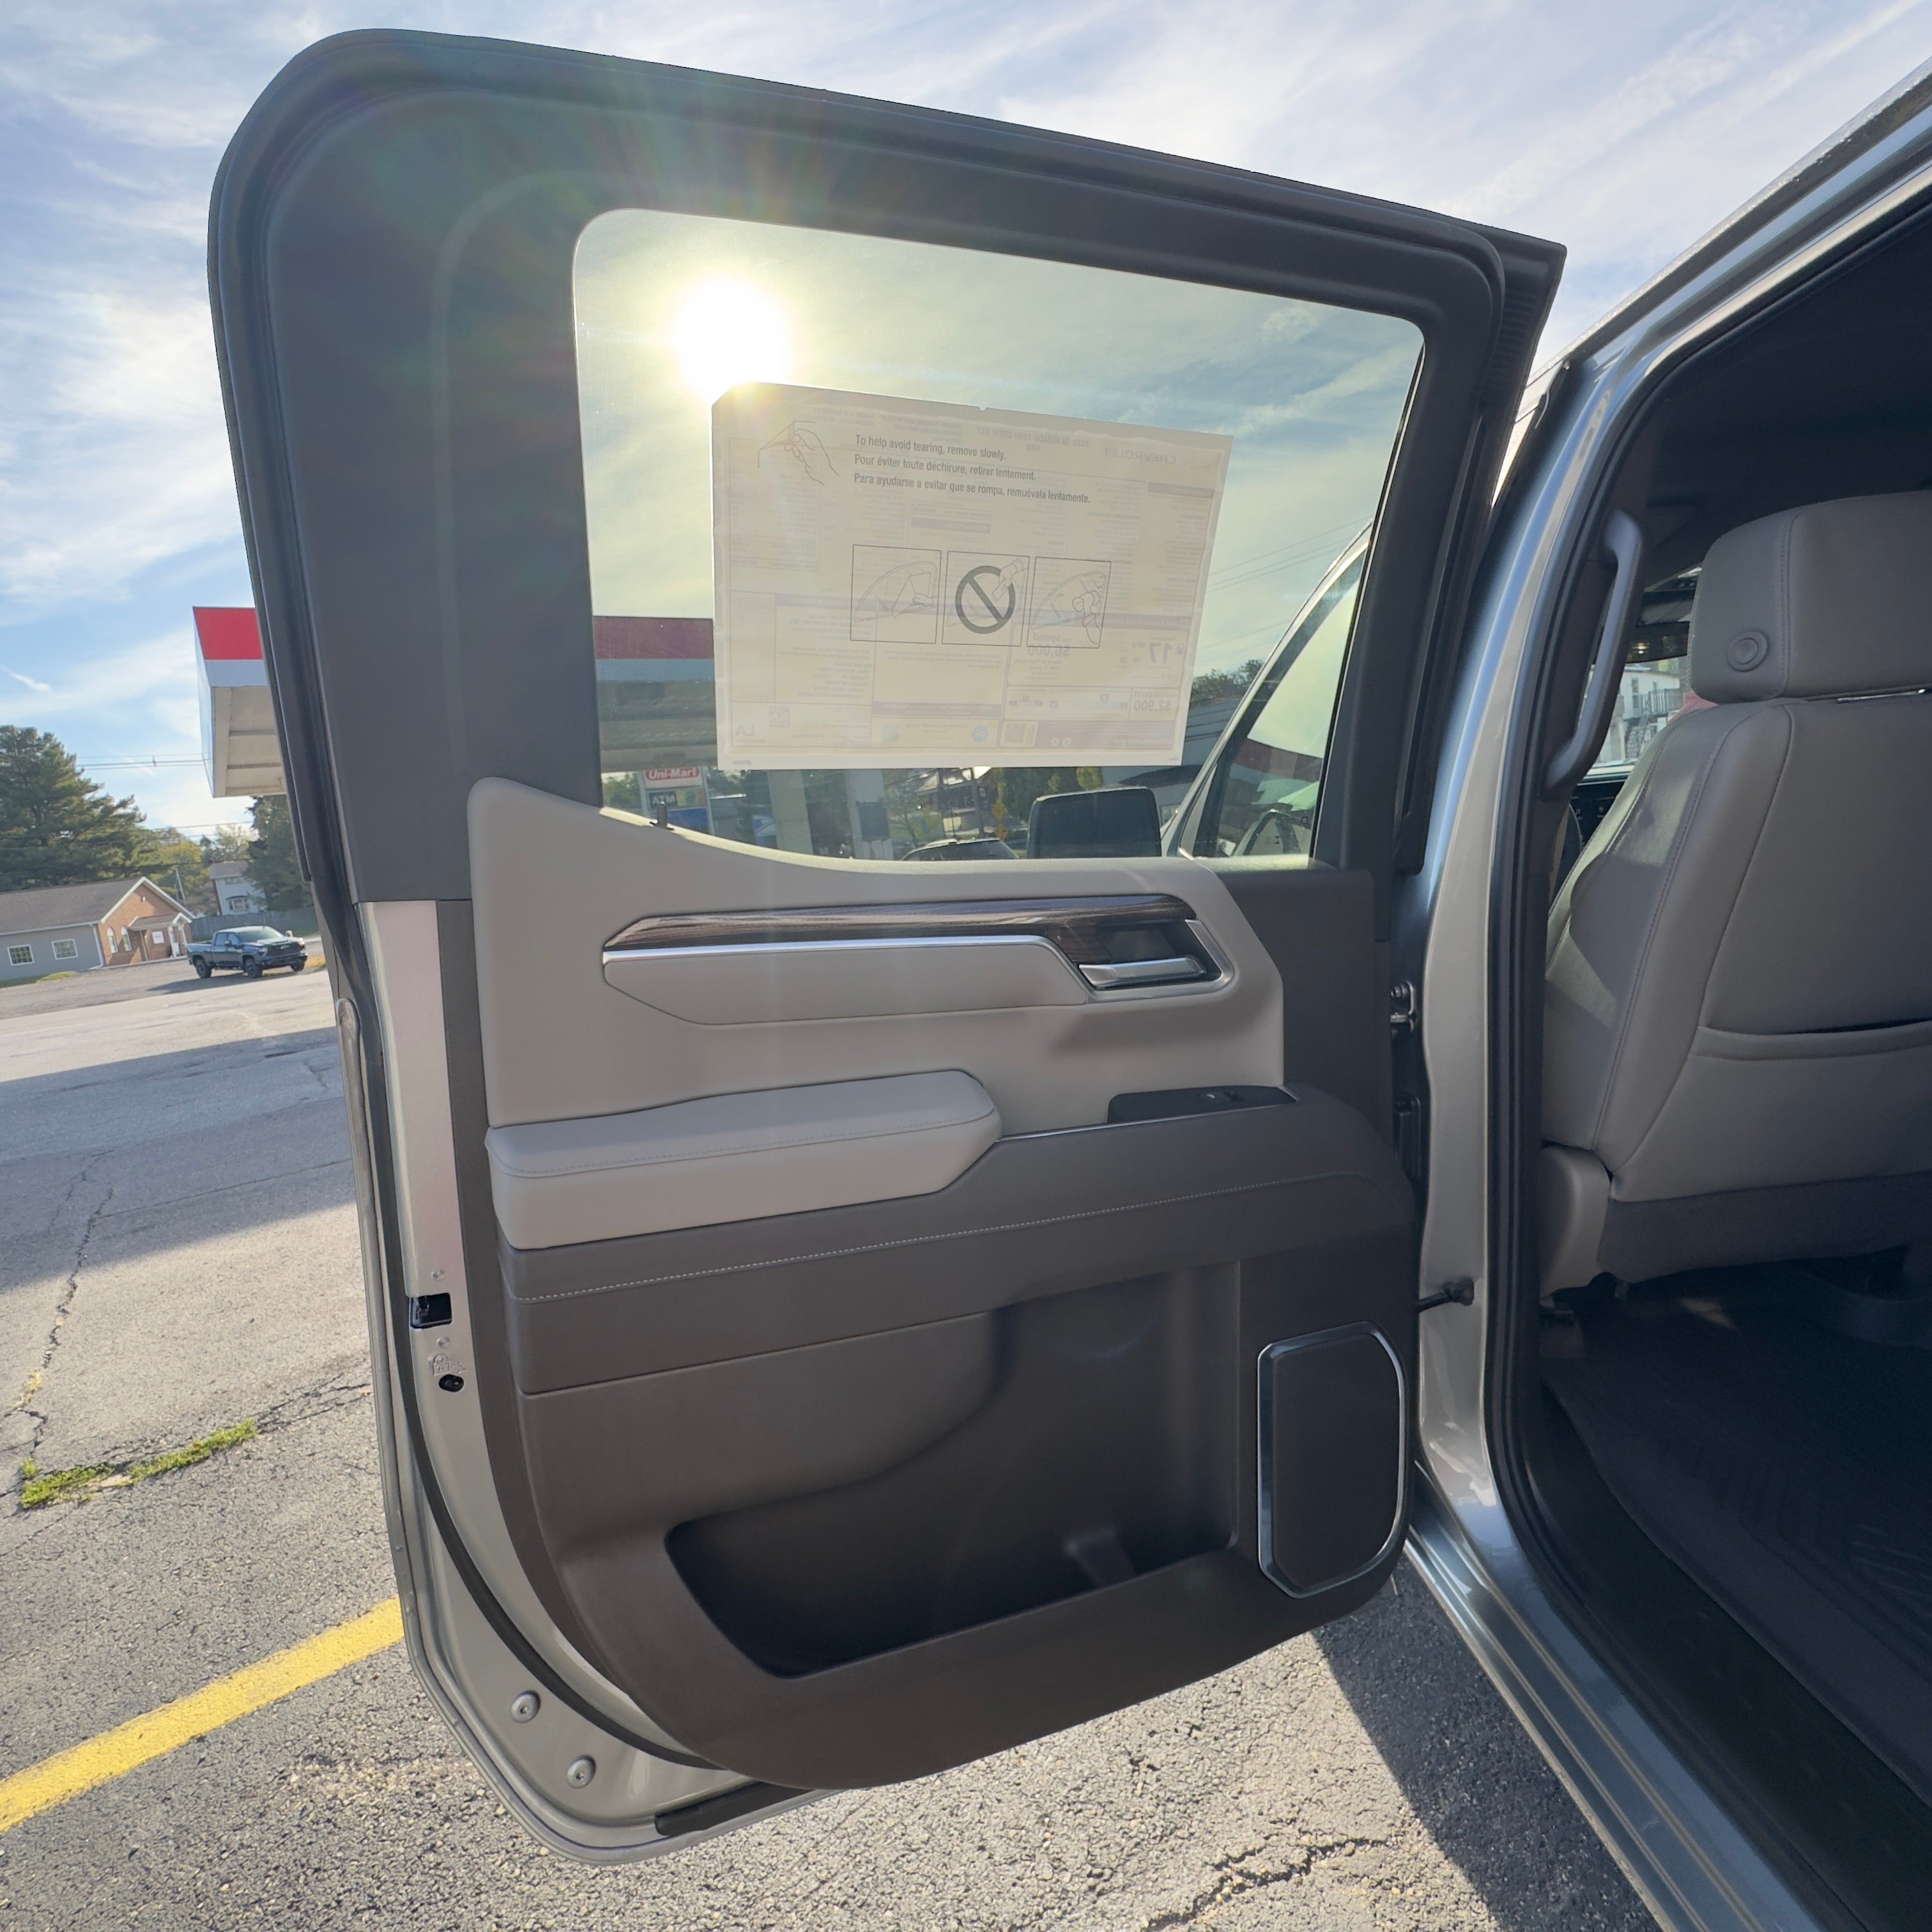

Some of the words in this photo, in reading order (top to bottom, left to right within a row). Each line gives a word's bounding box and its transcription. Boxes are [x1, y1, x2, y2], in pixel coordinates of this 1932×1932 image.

[855, 434, 866, 445] To
[868, 436, 887, 449] help
[889, 440, 911, 450] avoid
[914, 441, 945, 456] tearing,
[947, 447, 977, 456] remove
[979, 448, 1006, 461] slowly.
[855, 454, 875, 465] Pour
[877, 456, 901, 468] éviter
[903, 459, 924, 470] toute
[926, 461, 967, 476] déchirure,
[970, 466, 994, 476] retirer
[996, 468, 1036, 480] lentement.
[854, 473, 874, 484] Para
[877, 475, 914, 488] ayudarse
[924, 480, 947, 490] evitar
[949, 482, 965, 493] que
[967, 484, 976, 493] se
[978, 485, 1005, 496] rompa,
[1007, 488, 1046, 500] remuévala
[1048, 491, 1091, 503] lentamente.
[648, 768, 698, 779] Uni-Mart
[652, 795, 676, 804] ATM
